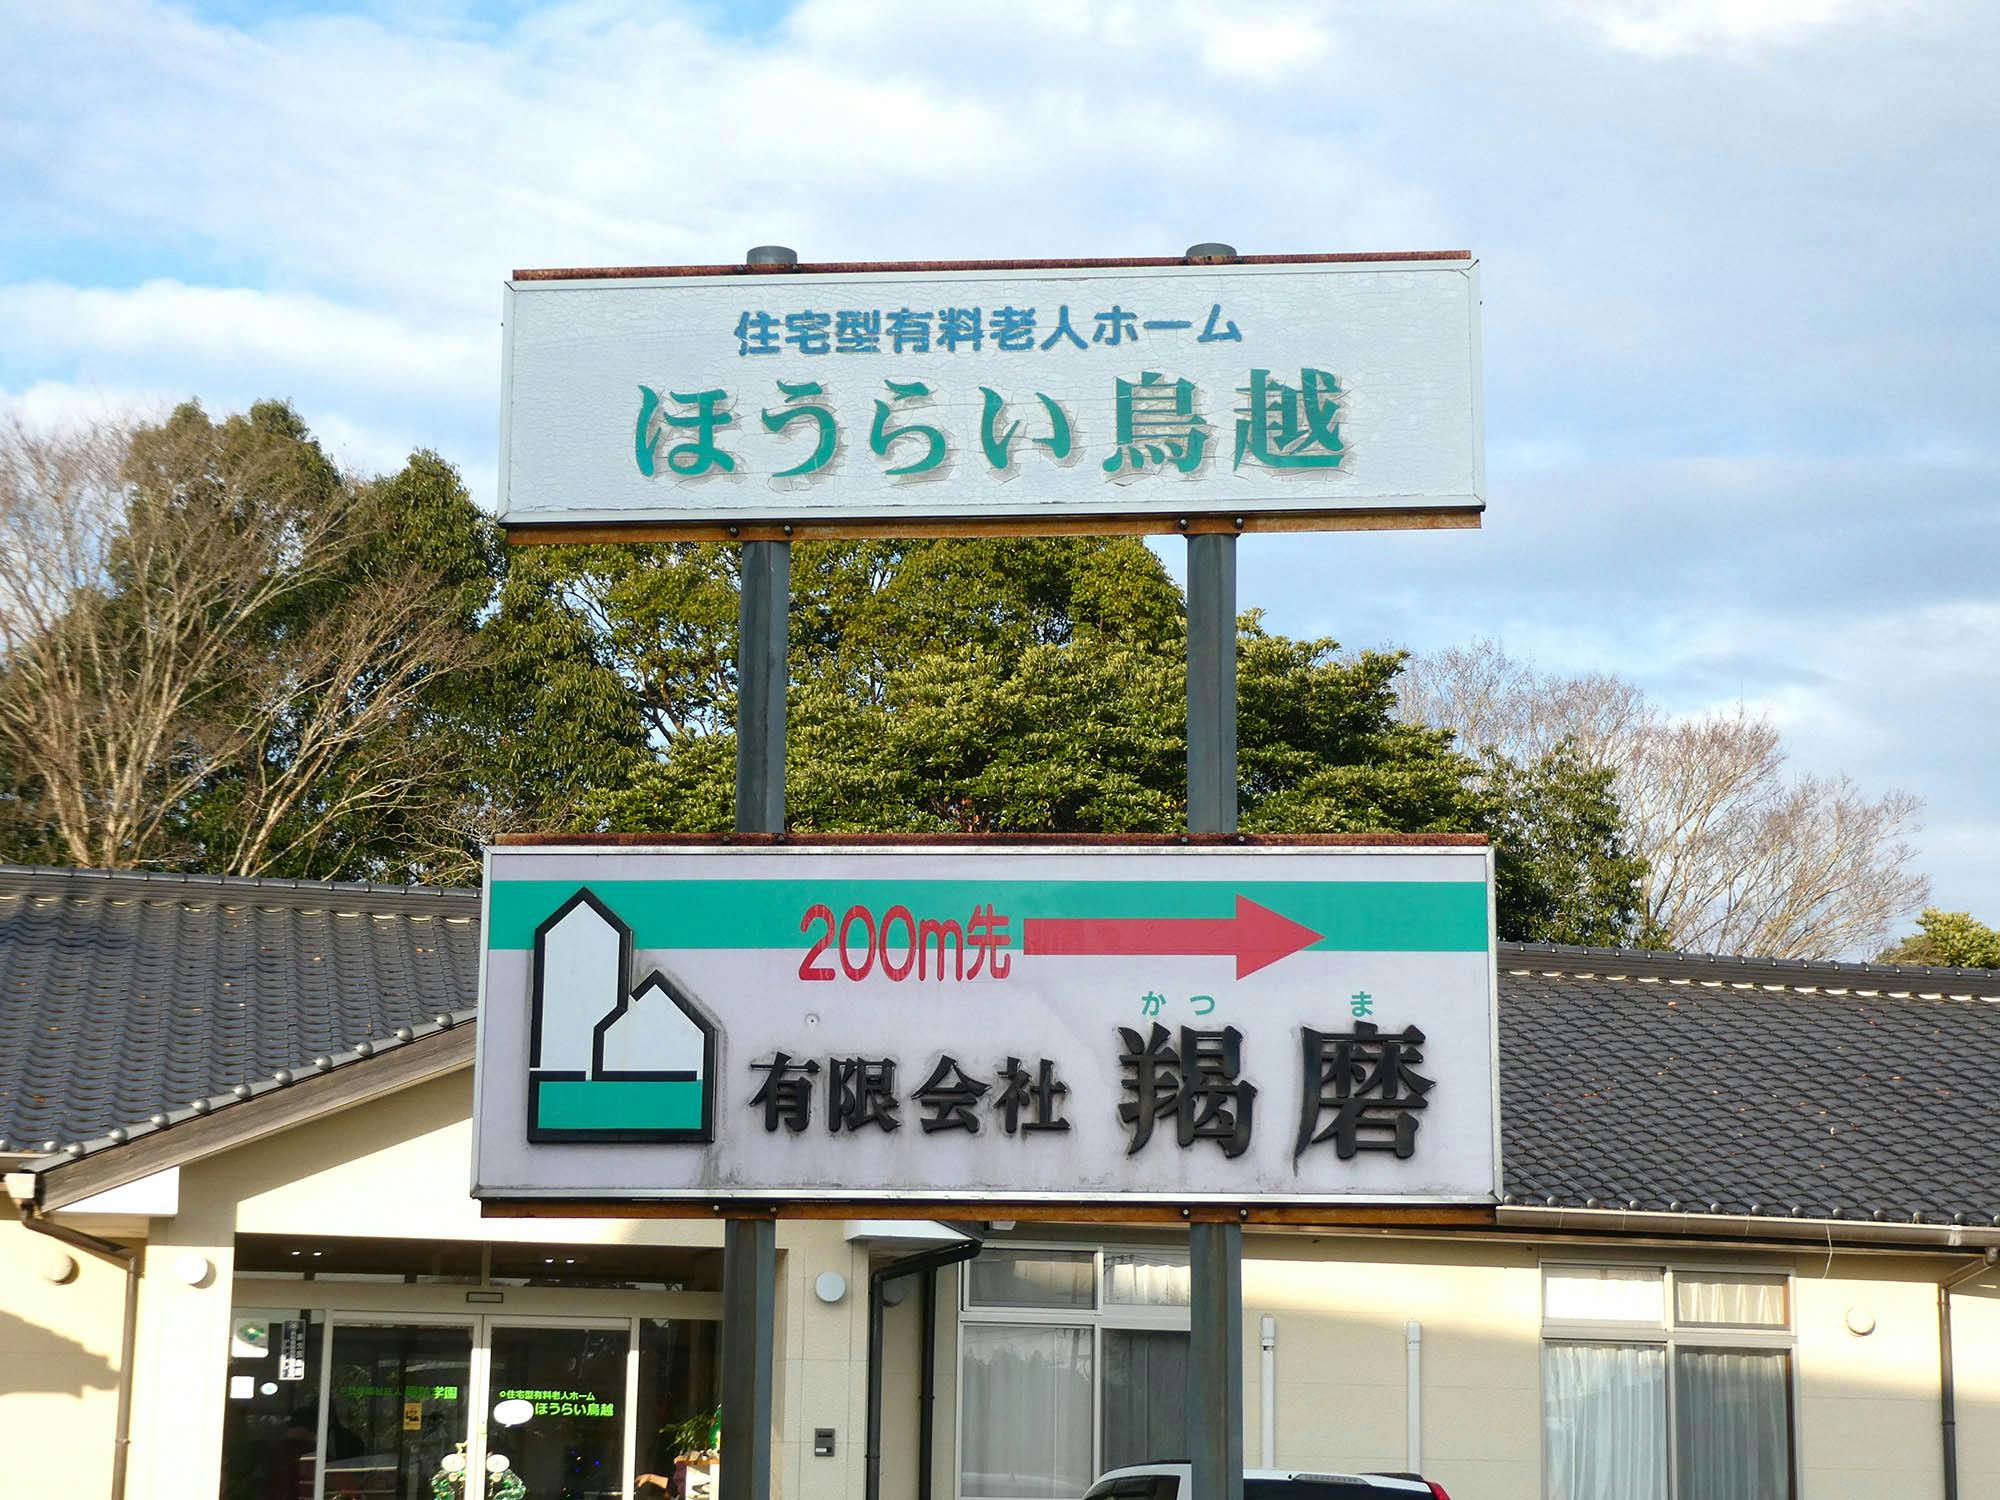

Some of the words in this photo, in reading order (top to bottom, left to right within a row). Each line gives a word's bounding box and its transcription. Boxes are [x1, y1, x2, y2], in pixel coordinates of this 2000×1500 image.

[735, 304, 1242, 356] 住宅型有料老人ホーム
[635, 368, 1345, 478] ほうらい鳥越
[799, 903, 1011, 983] 200m先
[748, 1051, 1072, 1137] 有限会社
[534, 1402, 614, 1417] ほうらい鳥越
